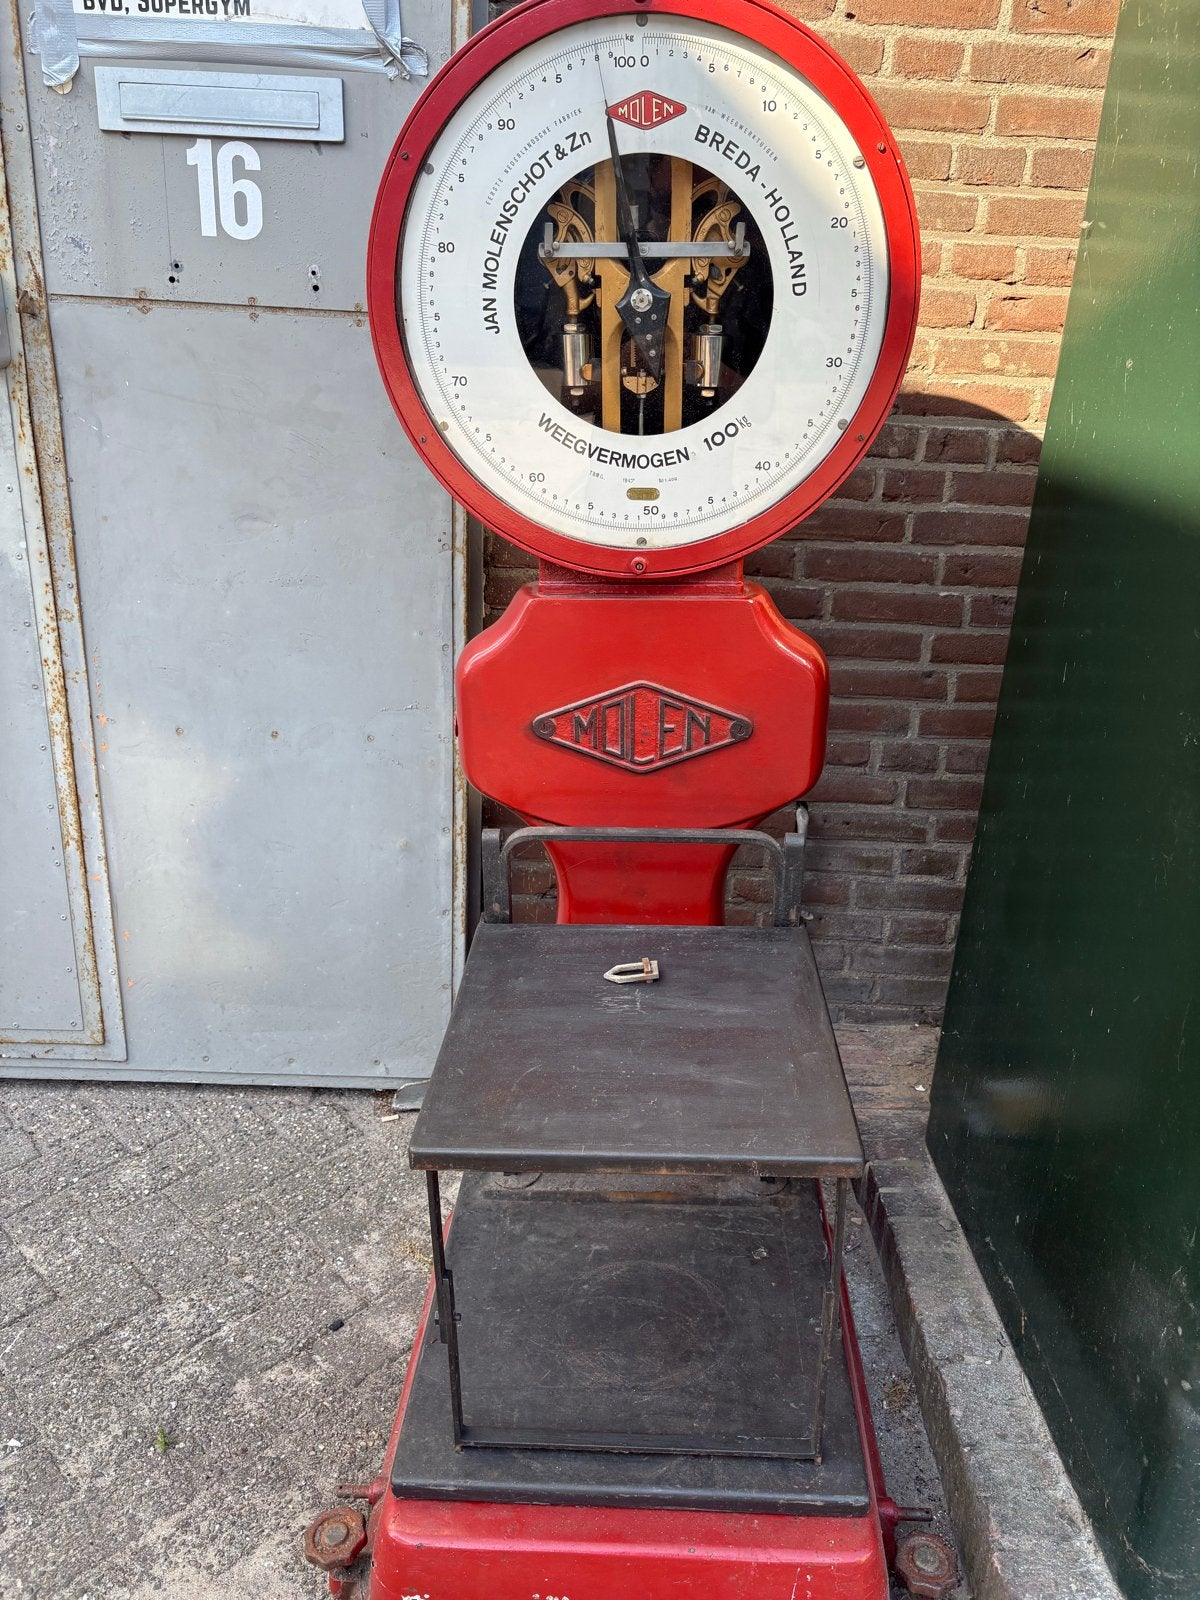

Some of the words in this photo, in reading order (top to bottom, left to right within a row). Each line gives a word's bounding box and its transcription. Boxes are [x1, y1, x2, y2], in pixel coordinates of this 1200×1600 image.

[138, 0, 251, 16] SUPERGYM
[625, 34, 634, 42] kg
[613, 55, 637, 68] 100
[639, 54, 650, 68] 0
[708, 63, 716, 74] 5
[555, 73, 563, 84] 5
[618, 96, 674, 126] MOLEN
[762, 100, 777, 112] 10
[497, 118, 516, 131] 90
[815, 149, 822, 160] 5
[458, 173, 465, 183] 5
[186, 138, 263, 240] 16
[482, 150, 553, 290] MOLENSCHOT
[830, 216, 849, 229] 20
[437, 241, 455, 254] 80
[850, 288, 858, 298] 5
[434, 312, 441, 322] 5
[483, 298, 500, 334] JAN
[825, 356, 843, 368] 30
[451, 375, 468, 387] 70
[807, 418, 814, 428] 5
[485, 433, 492, 442] 5
[538, 412, 690, 469] WEEGVERMOGEN
[754, 460, 771, 471] 40
[528, 472, 545, 483] 60
[587, 501, 594, 511] 5
[707, 496, 714, 505] 5
[643, 505, 660, 516] 50
[573, 694, 711, 763] MOLEN
